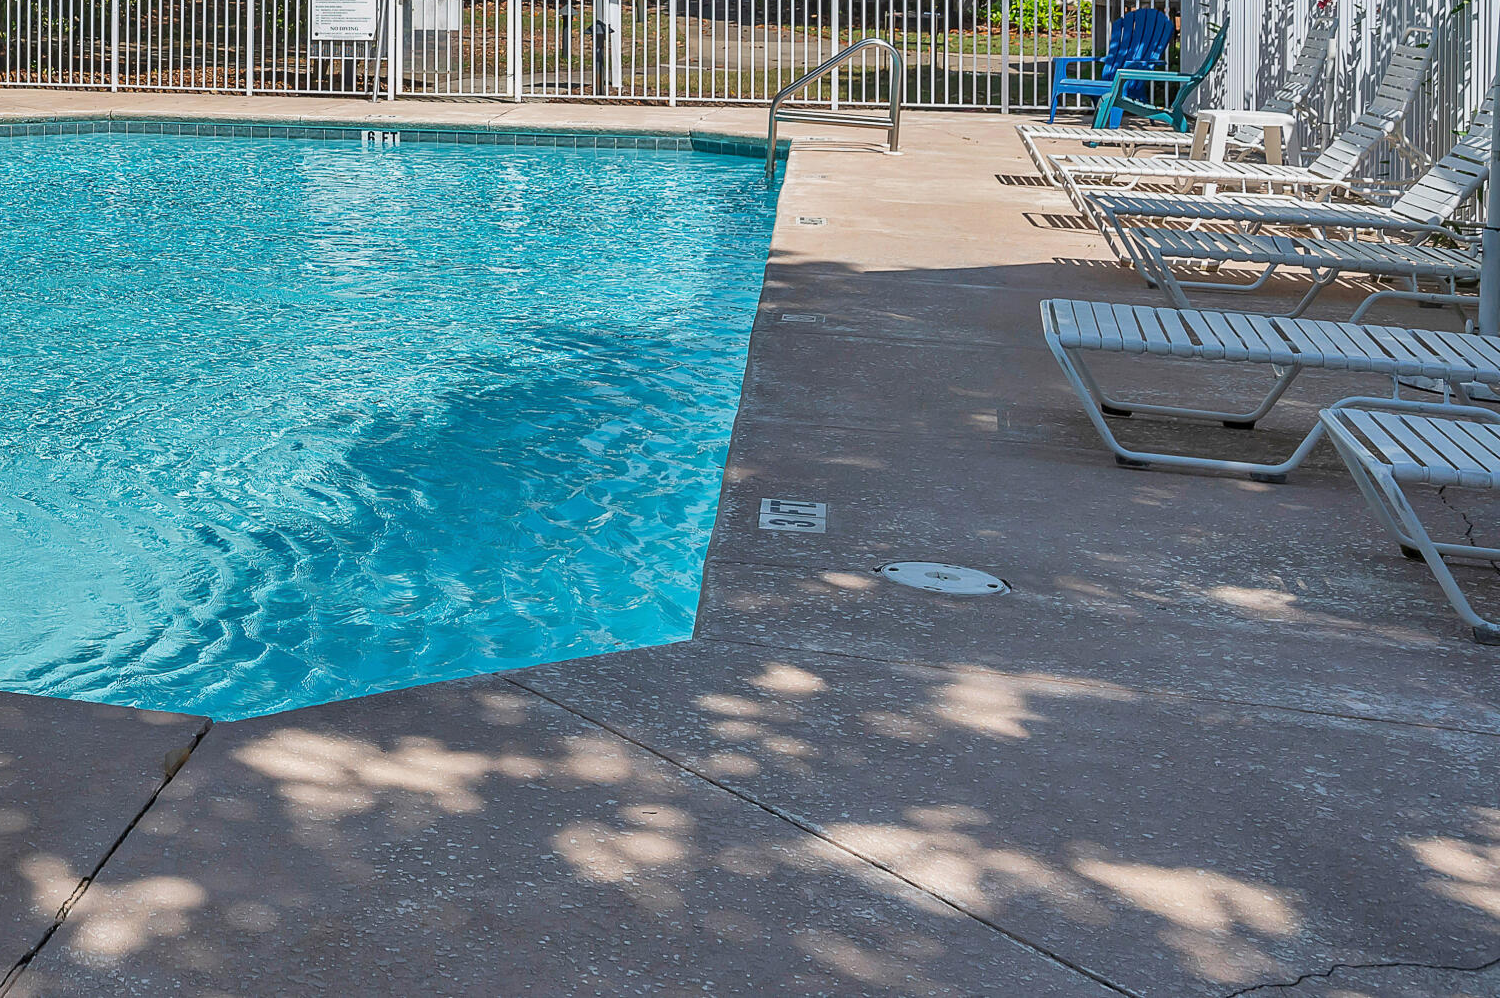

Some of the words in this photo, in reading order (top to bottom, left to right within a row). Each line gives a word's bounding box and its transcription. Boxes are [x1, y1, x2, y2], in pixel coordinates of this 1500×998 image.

[382, 131, 398, 143] FT
[769, 500, 817, 516] FT
[768, 518, 817, 528] 3
